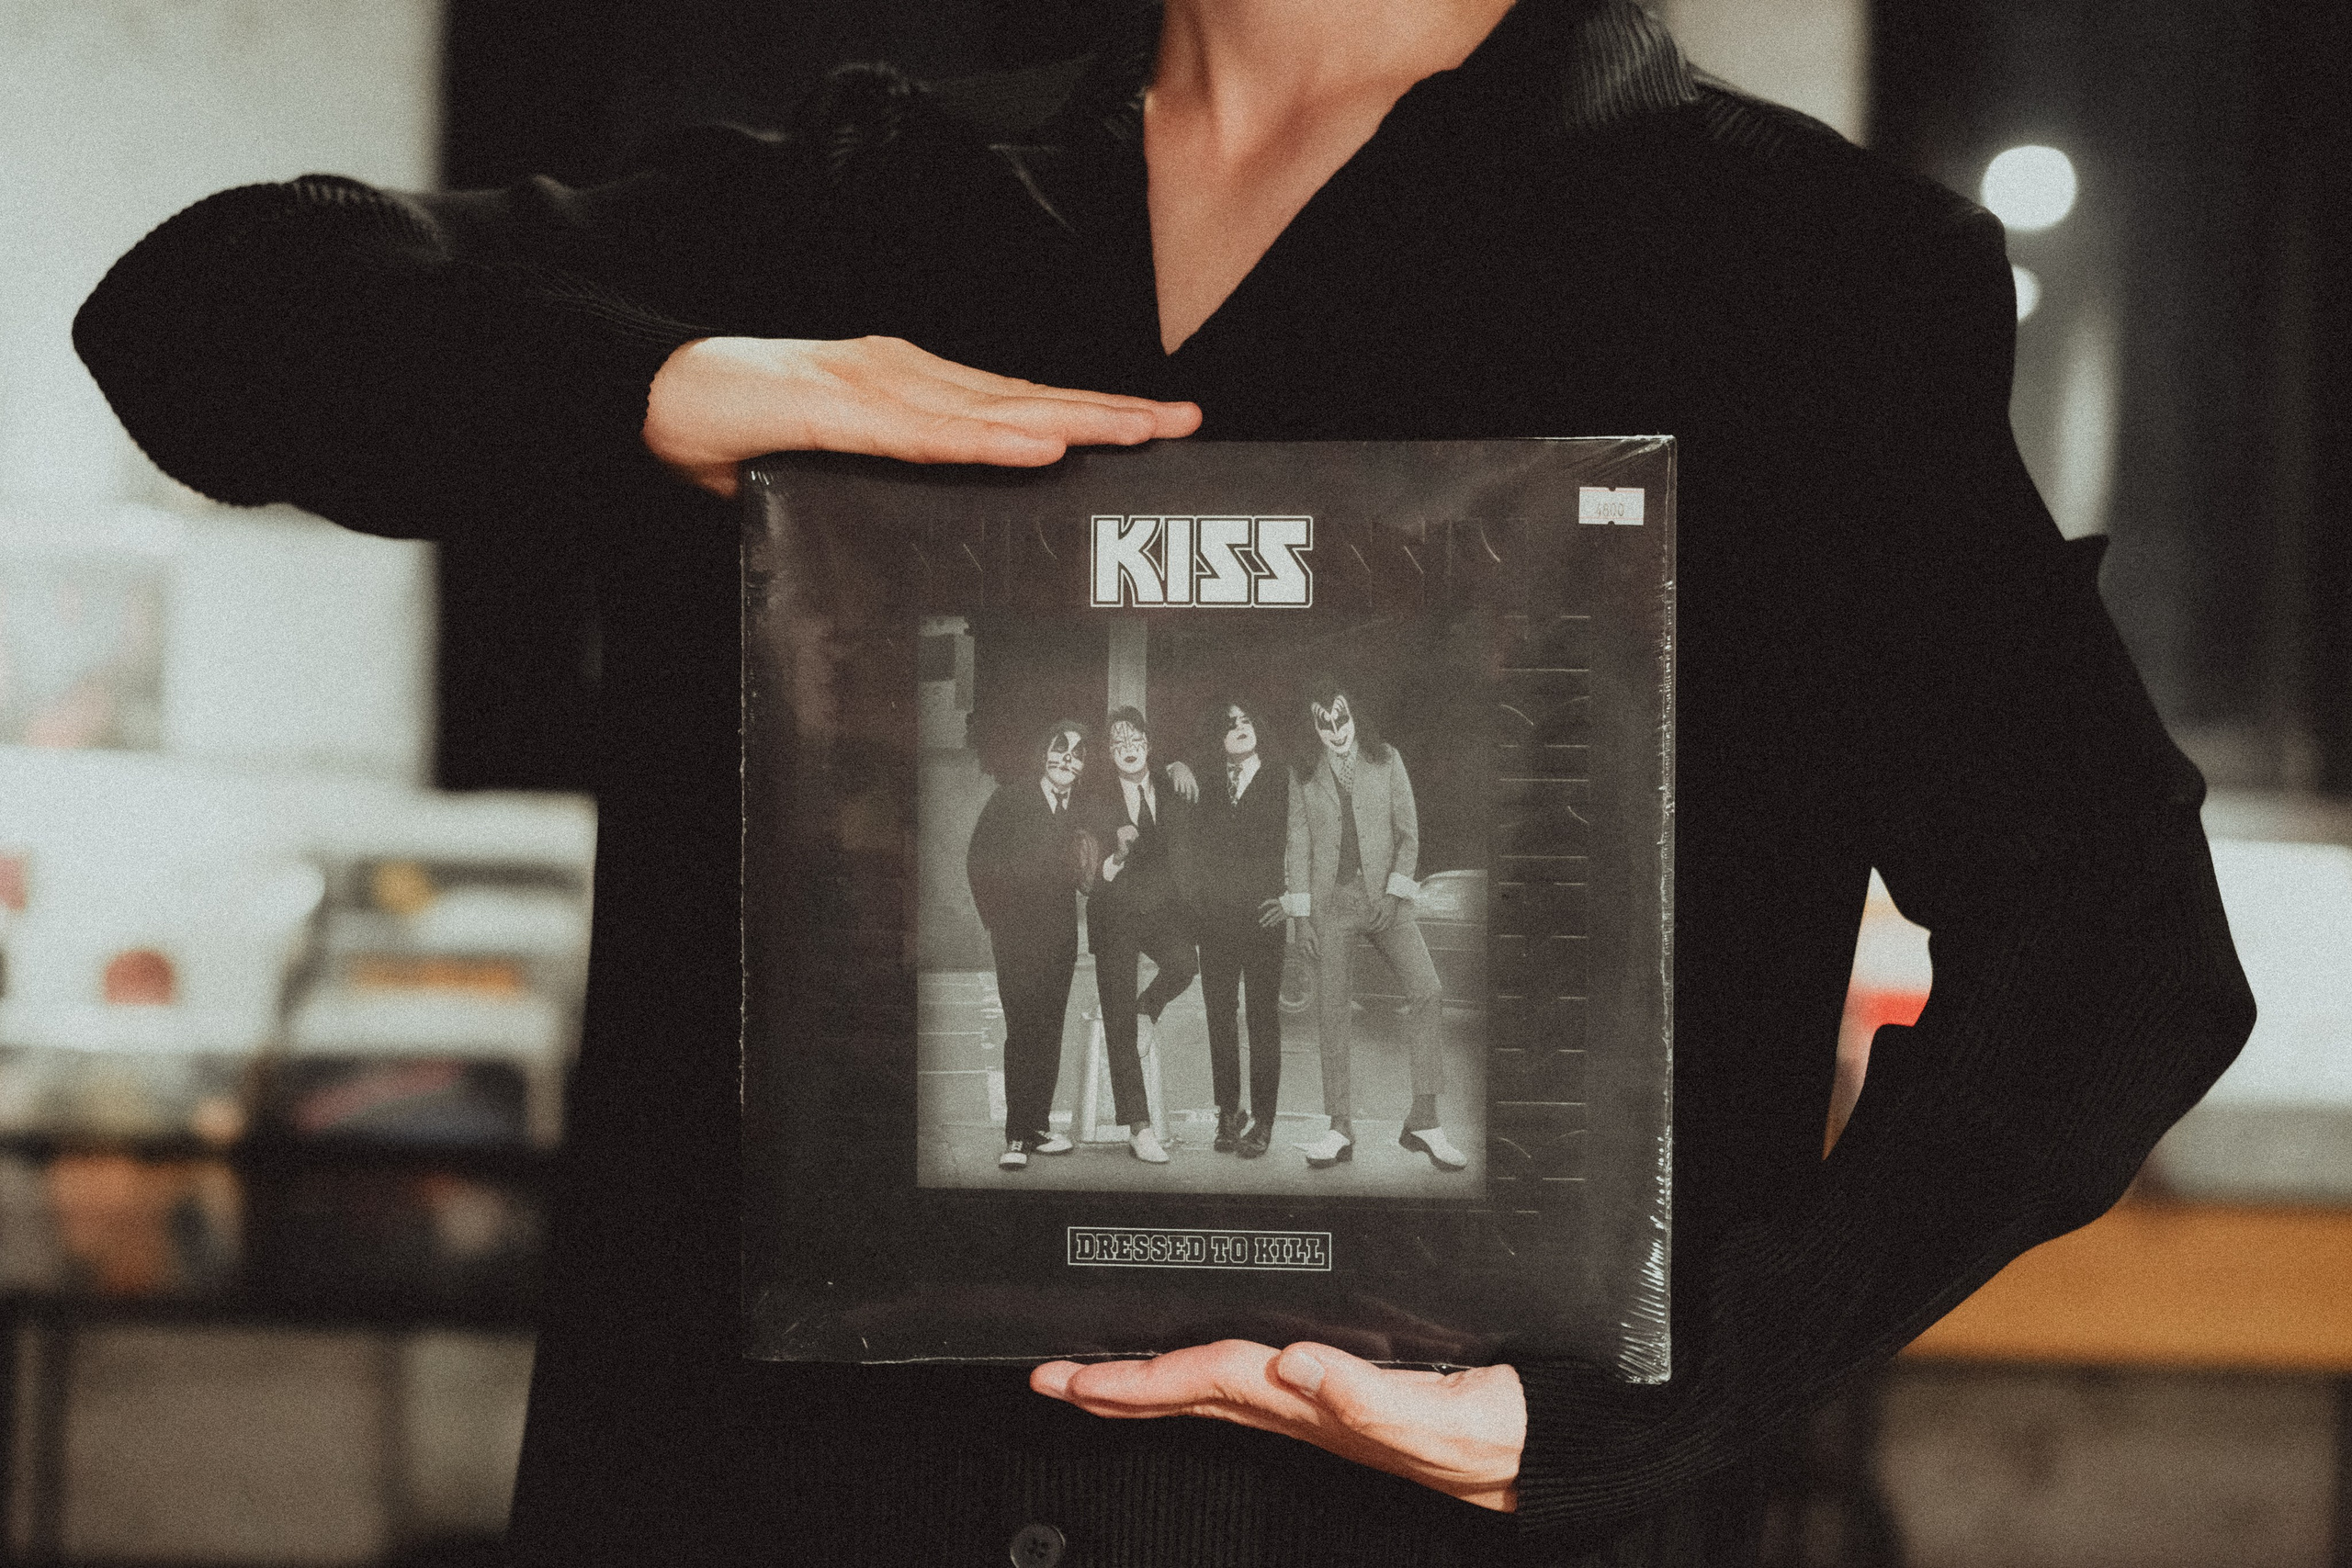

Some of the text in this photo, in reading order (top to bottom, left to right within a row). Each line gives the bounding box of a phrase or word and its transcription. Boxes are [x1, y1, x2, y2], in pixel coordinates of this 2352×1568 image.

[1091, 515, 1313, 608] KISS
[1076, 1233, 1325, 1266] DRESSED TO KILL
